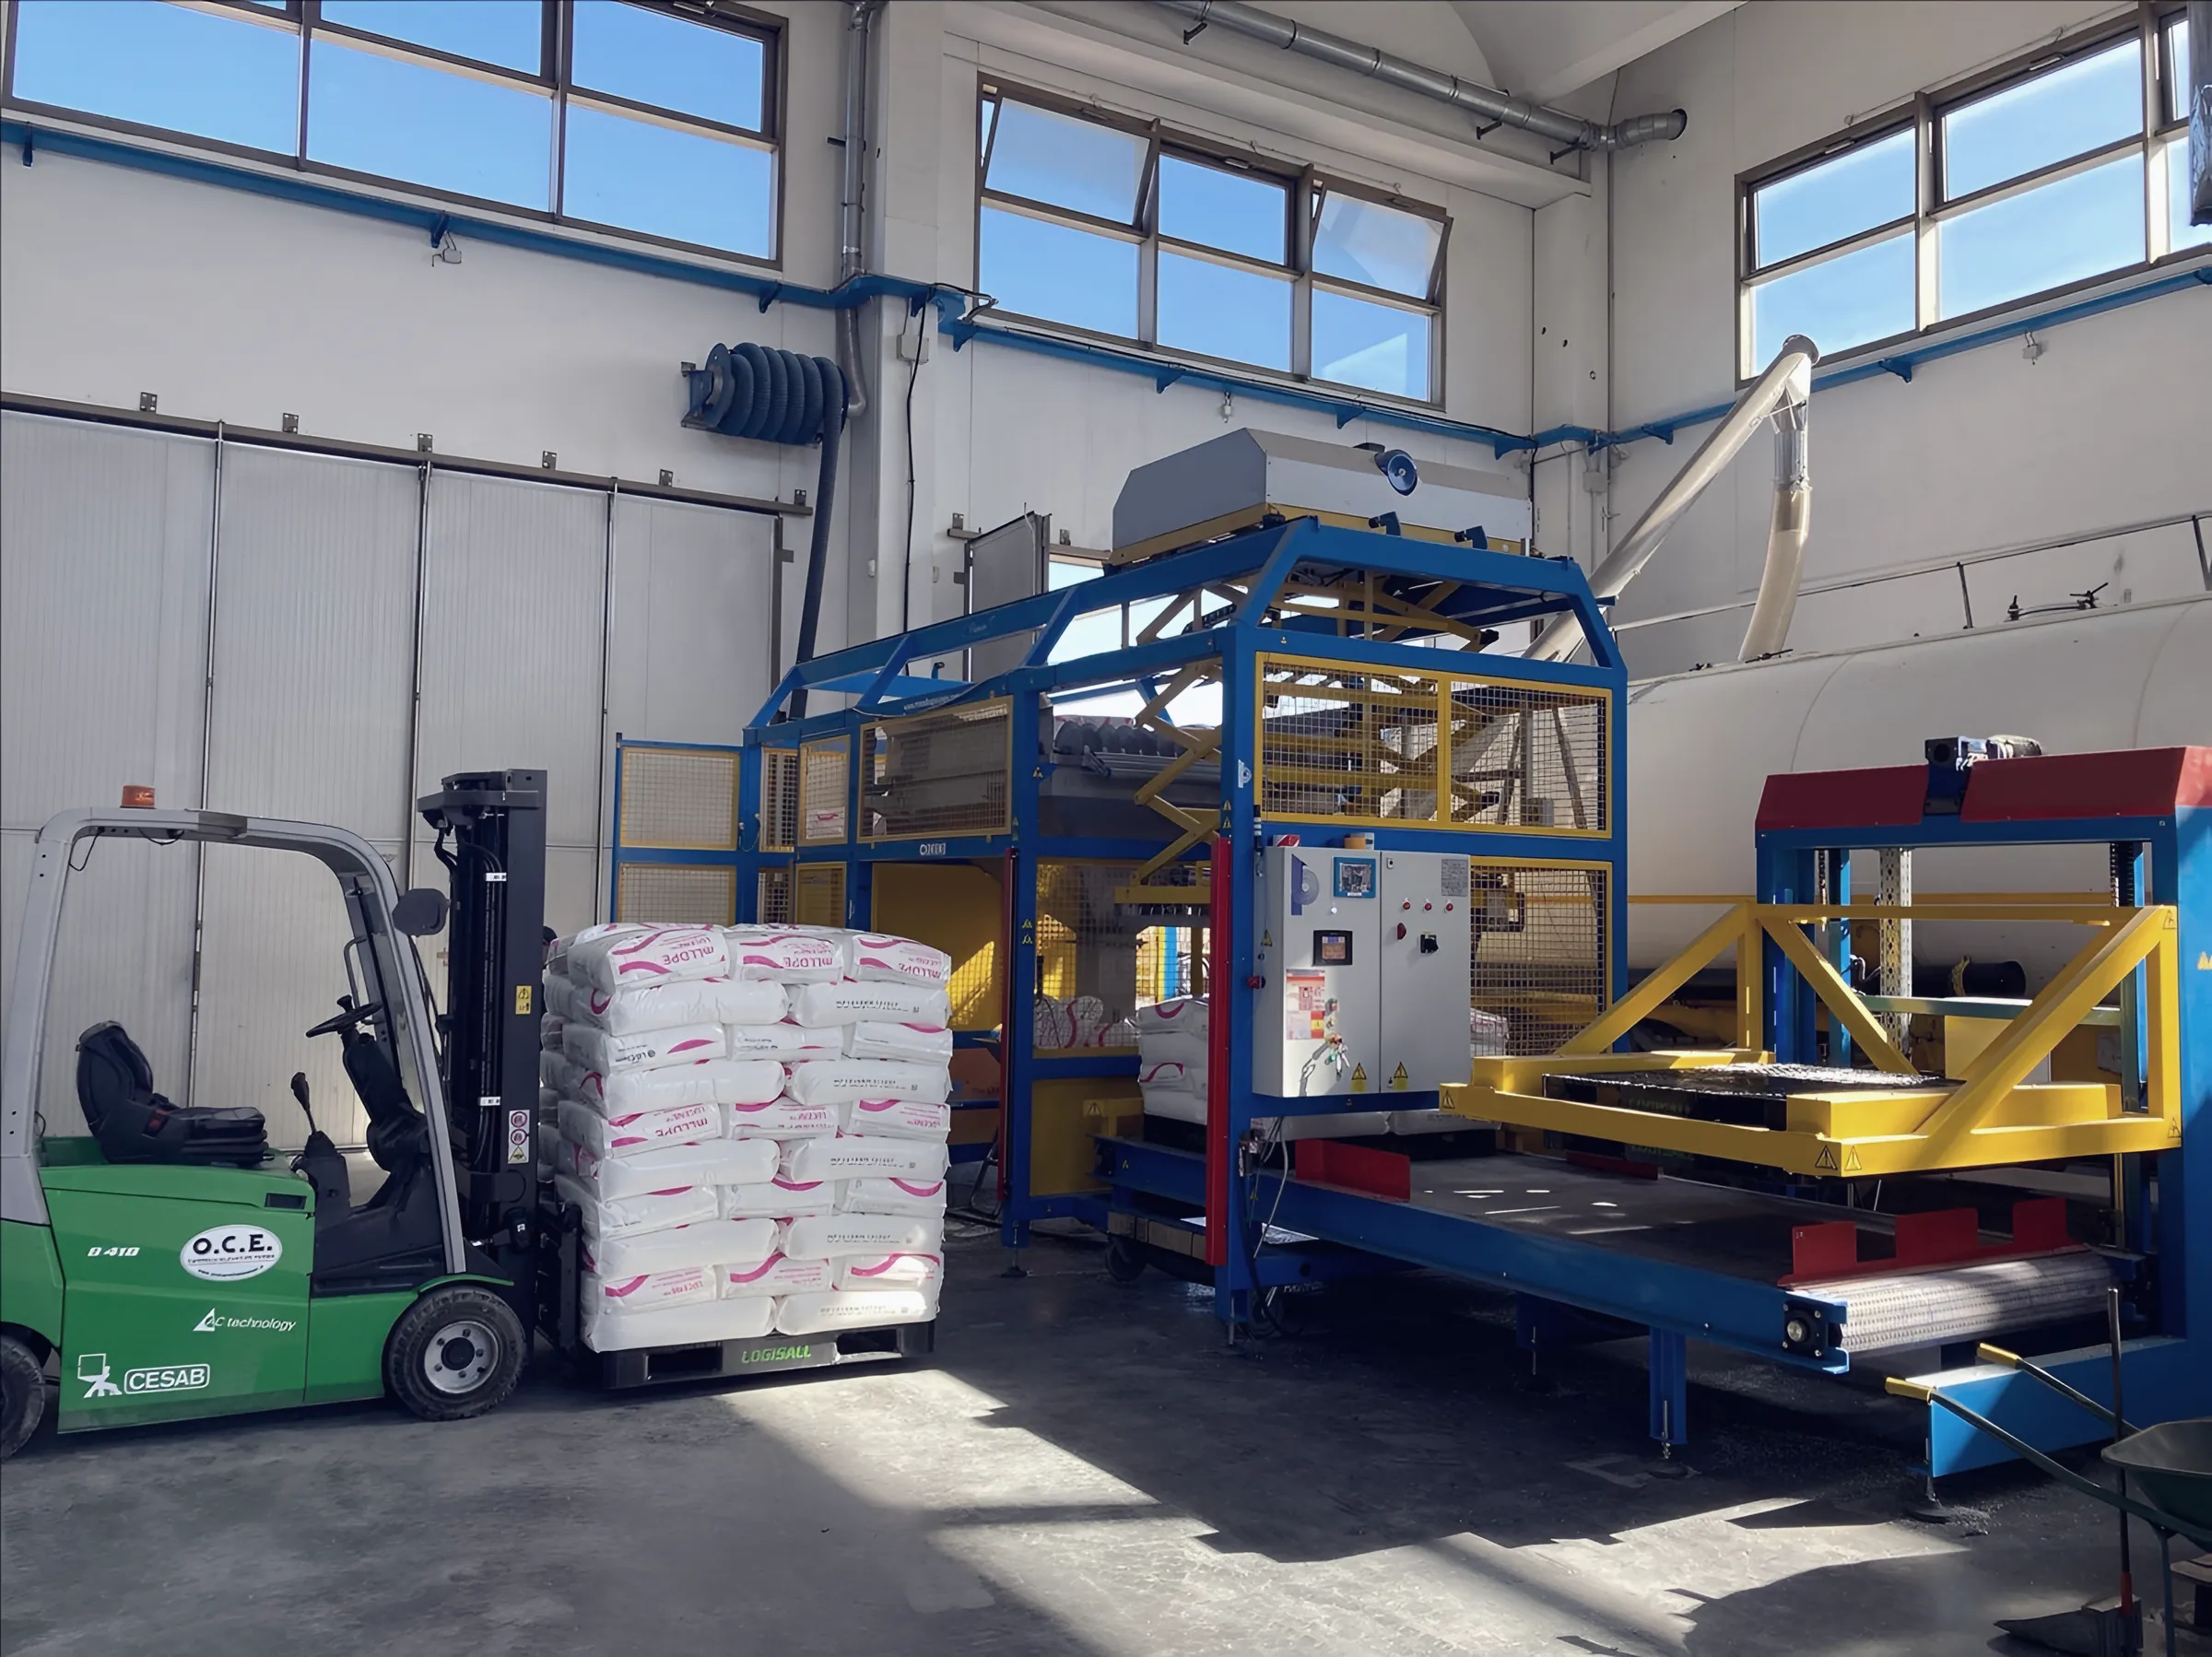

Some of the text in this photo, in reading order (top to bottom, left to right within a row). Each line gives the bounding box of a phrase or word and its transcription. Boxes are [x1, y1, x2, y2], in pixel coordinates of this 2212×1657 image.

[662, 946, 714, 965] mLLDPE
[193, 1234, 273, 1255] O.C.E.
[227, 1317, 296, 1332] technology
[741, 1345, 811, 1364] LOGISALL
[129, 1368, 206, 1391] CESAB
